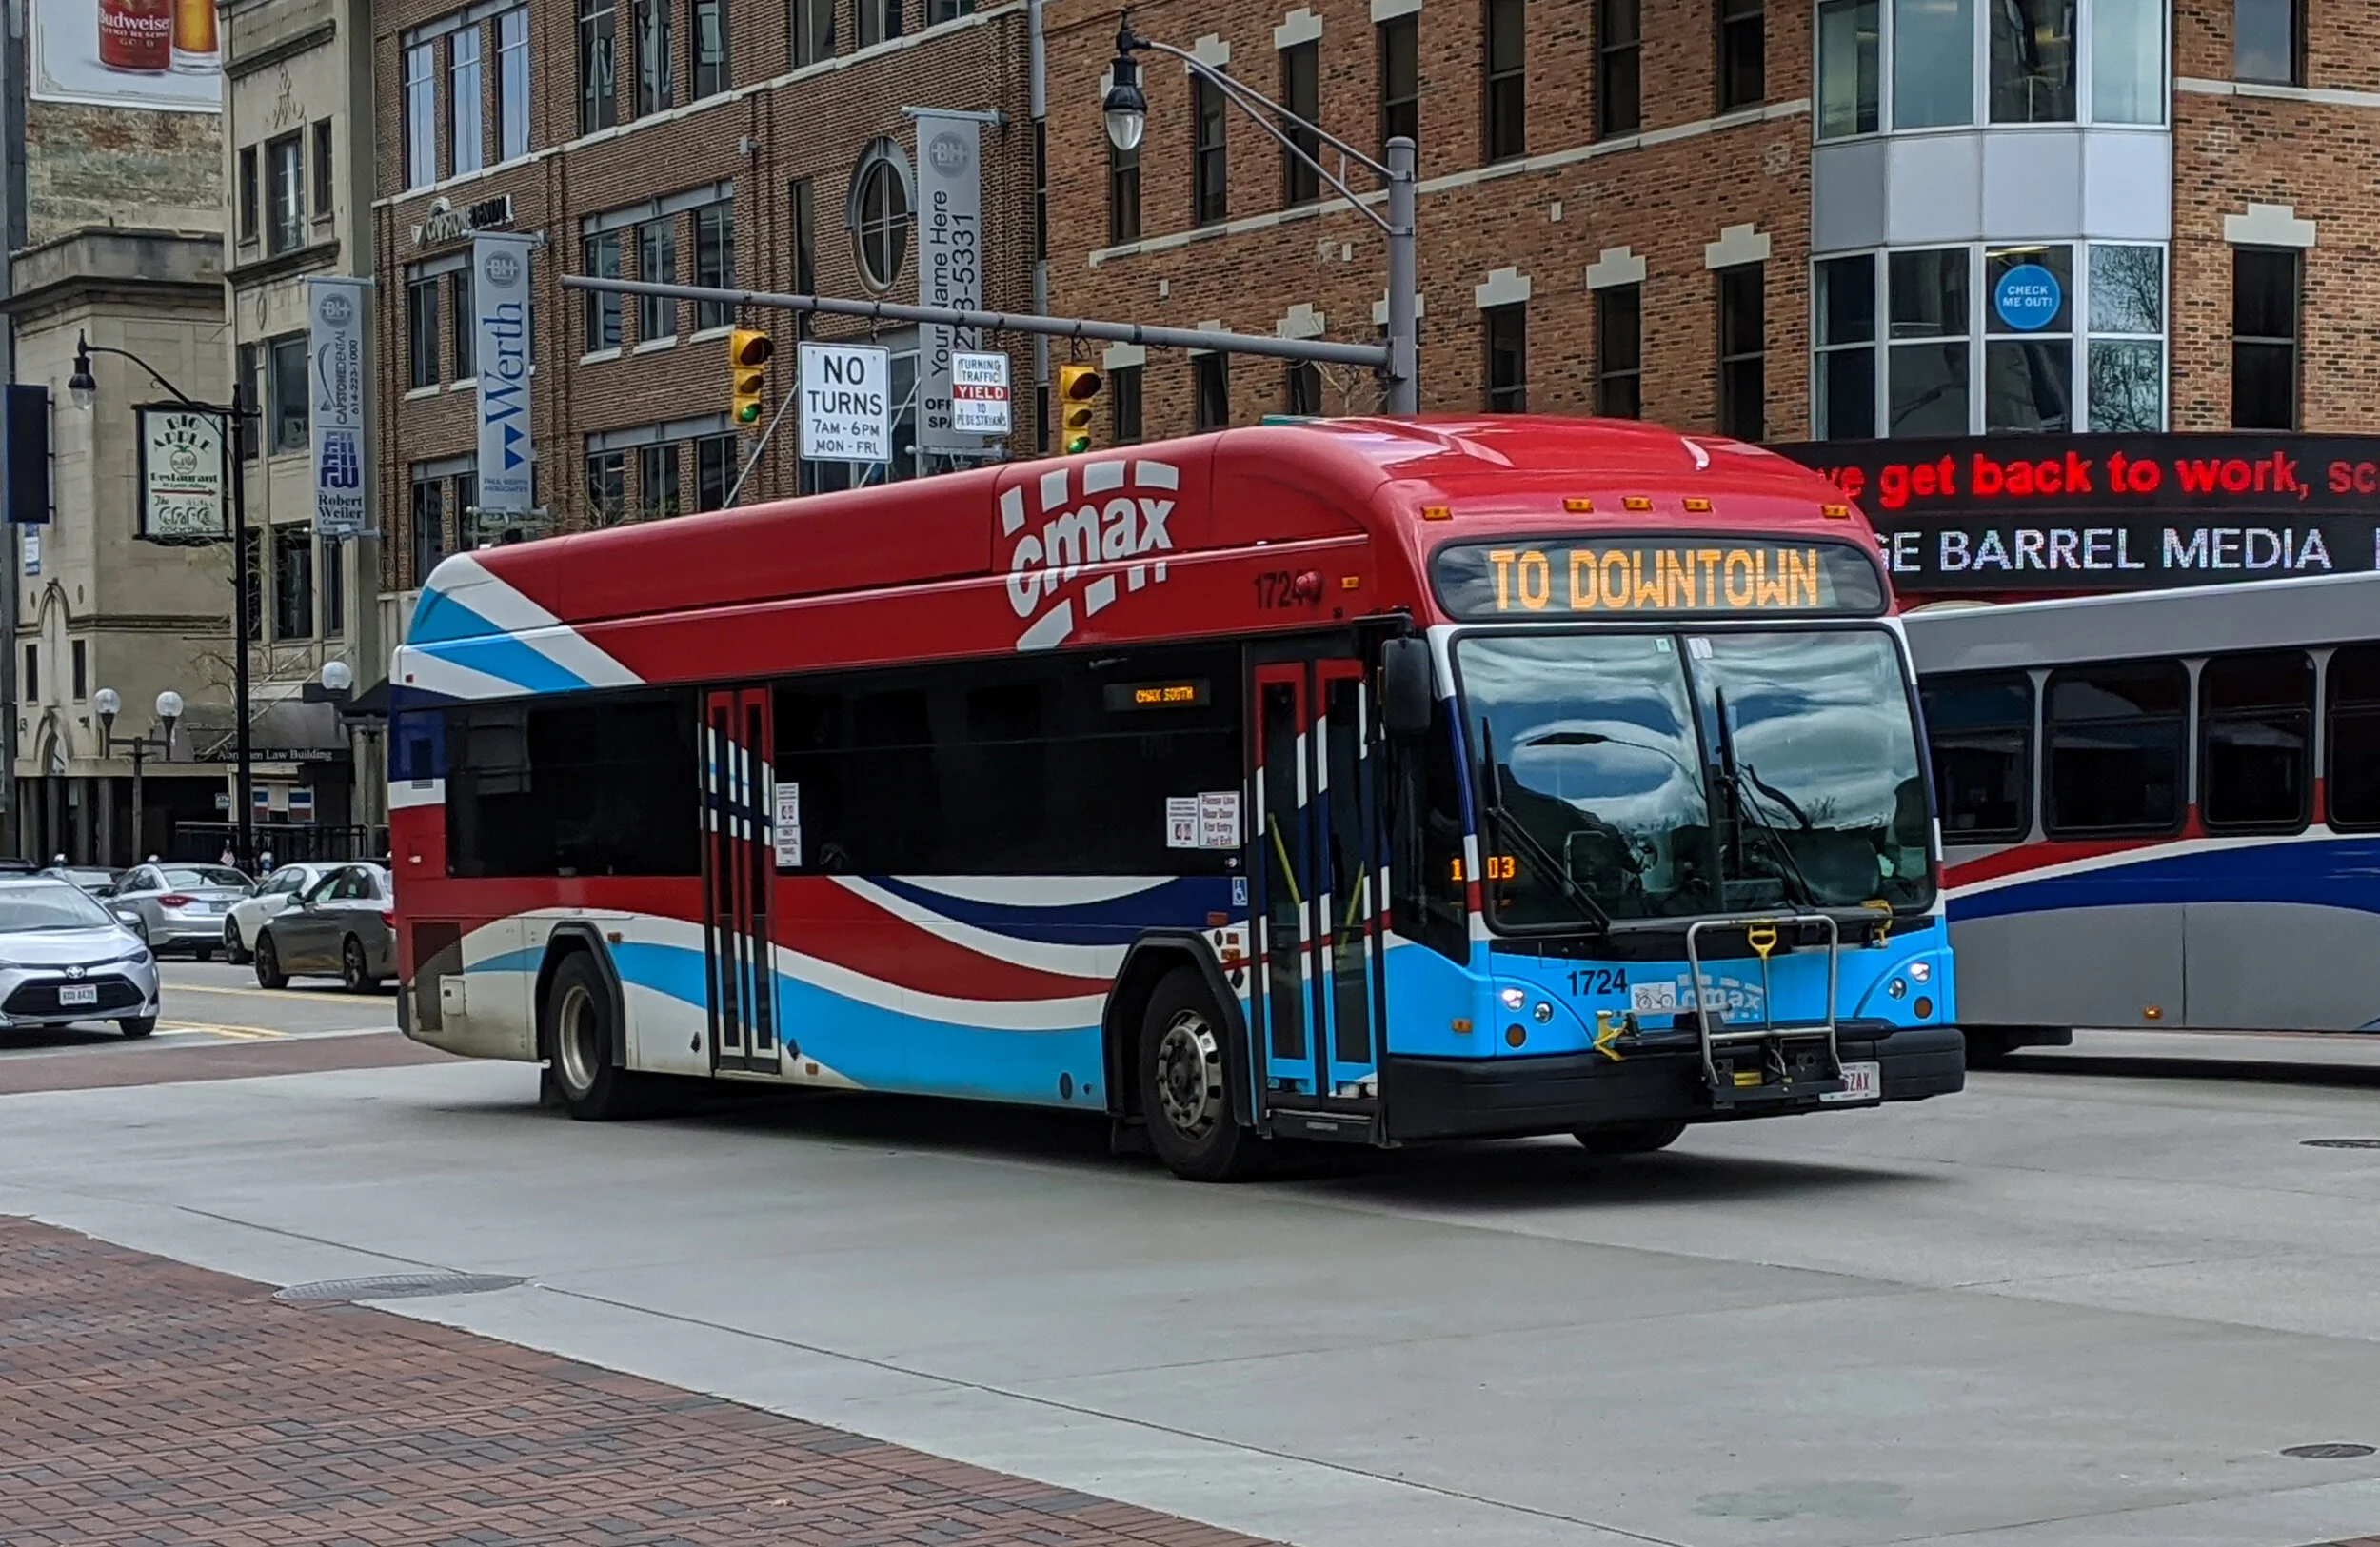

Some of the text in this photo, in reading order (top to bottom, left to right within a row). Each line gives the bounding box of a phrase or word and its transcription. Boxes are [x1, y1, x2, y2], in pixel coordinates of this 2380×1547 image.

[929, 190, 948, 245] Here
[2007, 285, 2049, 296] CHECK
[2002, 296, 2053, 307] ME OUT!
[930, 327, 948, 377] Your
[483, 300, 524, 426] Werth
[823, 354, 865, 386] NO
[958, 358, 1002, 372] TURNING
[348, 339, 360, 416] 614-223-1000
[962, 371, 999, 385] TRAFFIC
[958, 386, 1004, 400] YIELD
[807, 390, 883, 416] TURNS
[976, 403, 987, 414] TO
[166, 414, 203, 431] BIG
[812, 418, 841, 435] 7AM
[850, 421, 880, 437] 6PM
[956, 411, 1007, 427] PEDESTRIANS
[153, 430, 214, 453] APPLE
[815, 439, 844, 454] MON
[1880, 454, 1957, 508] get
[1973, 450, 2093, 496] back
[2107, 450, 2161, 493] to
[2175, 450, 2308, 501] work,
[318, 494, 363, 507] Robert
[318, 506, 364, 520] Weiler
[1006, 496, 1176, 619] cmax
[1940, 527, 2146, 571] BARREL
[2163, 527, 2333, 569] MEDIA
[1490, 548, 1818, 610] TO DOWNTOWN
[266, 749, 287, 761] Law
[289, 748, 333, 762] Building
[1567, 968, 1627, 996] 1724
